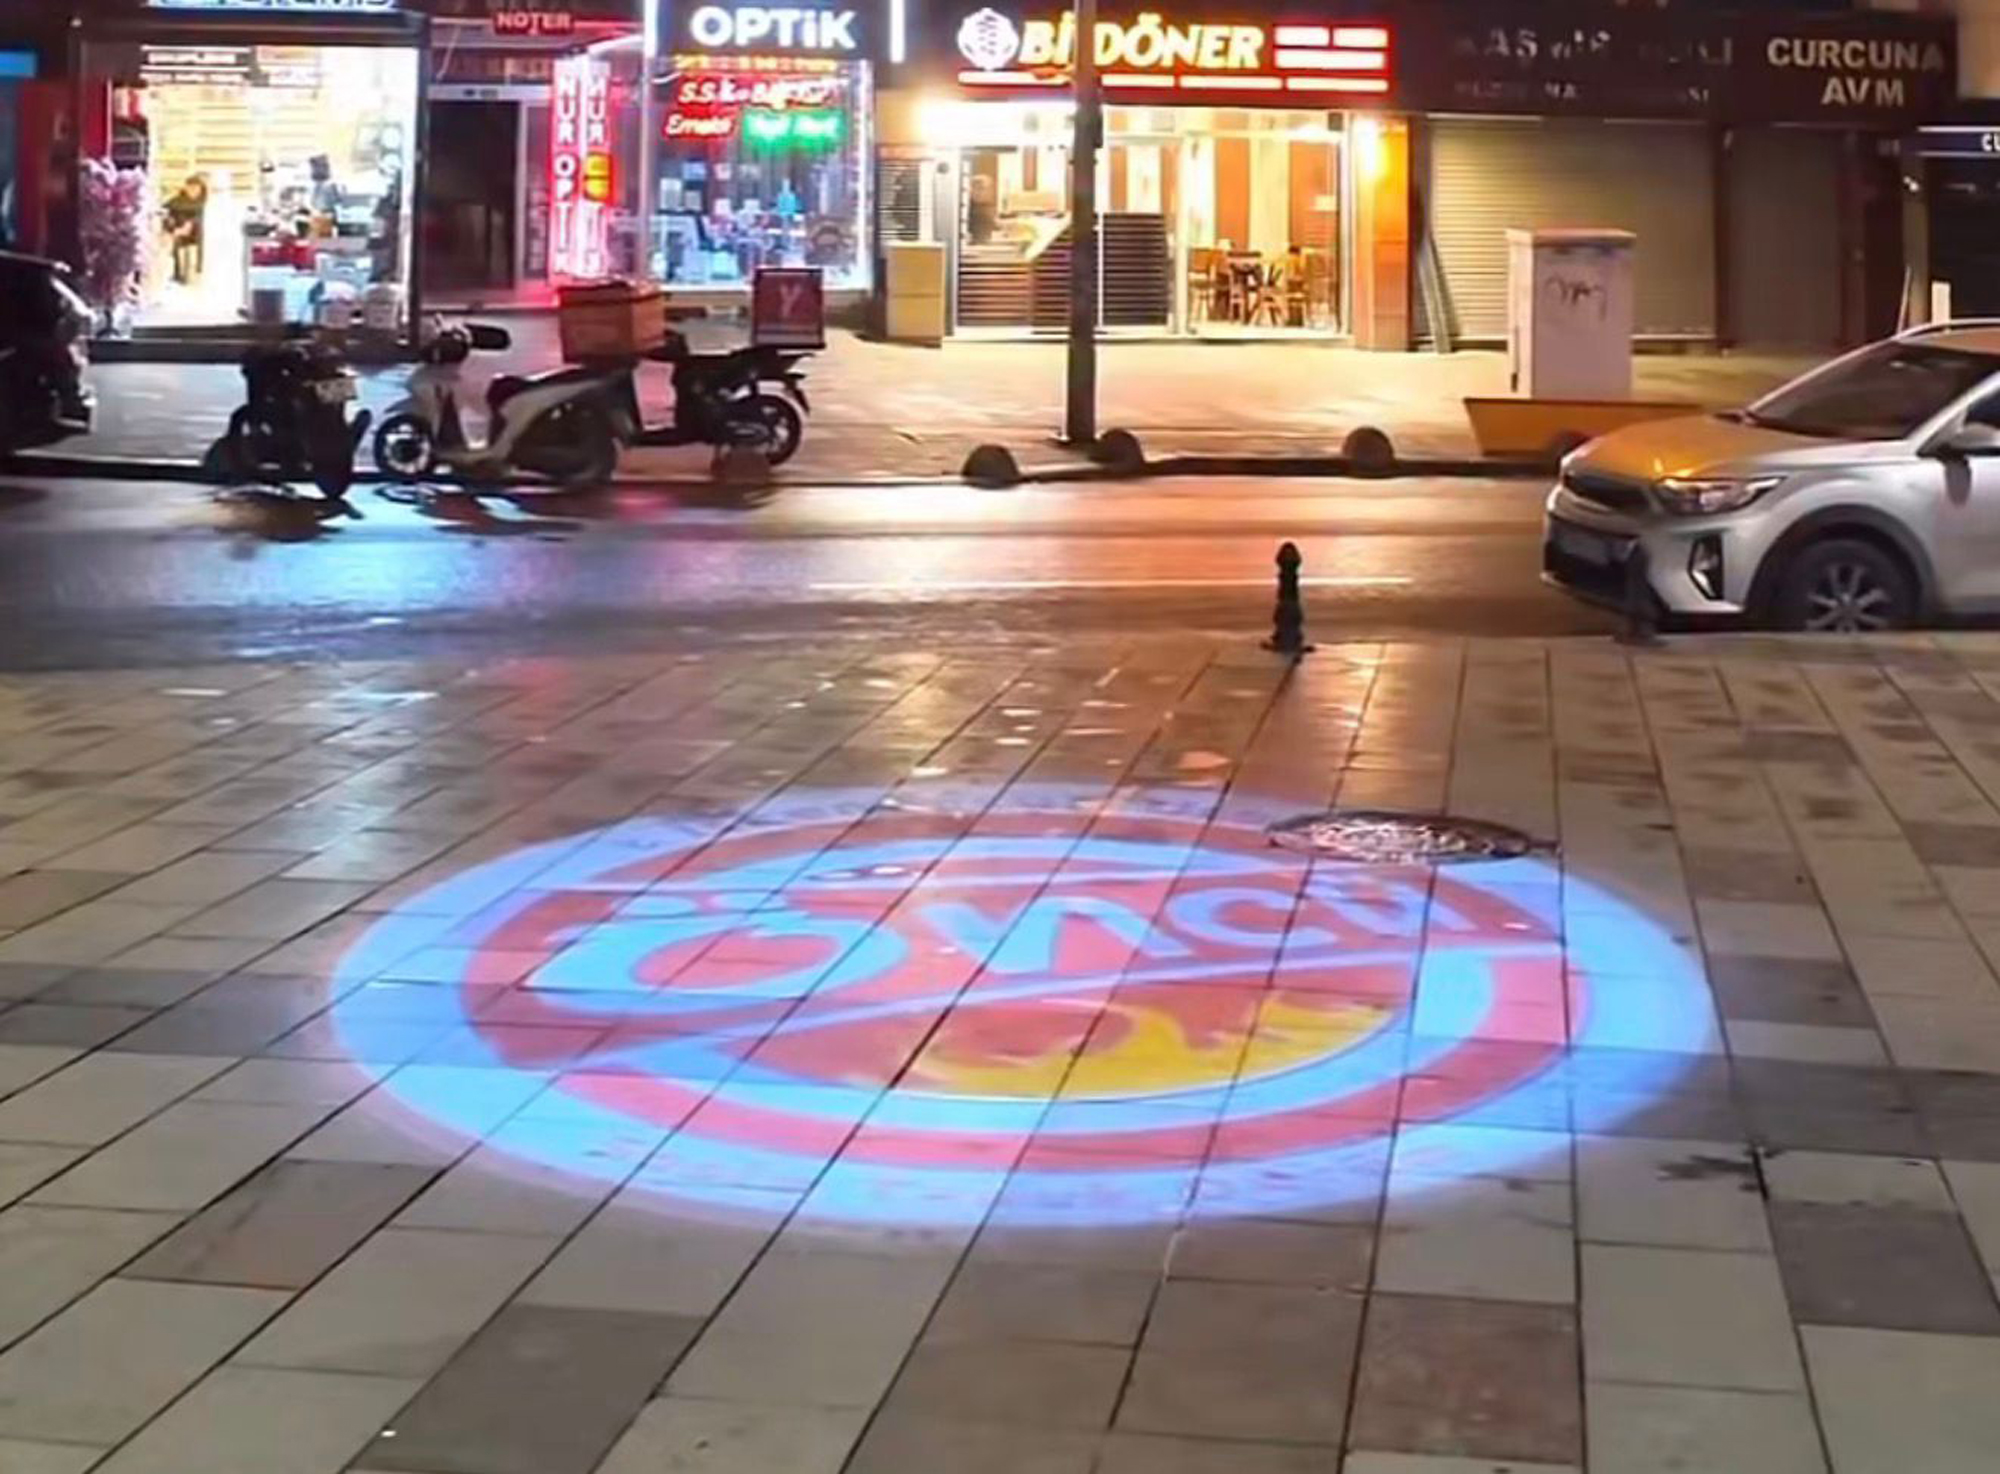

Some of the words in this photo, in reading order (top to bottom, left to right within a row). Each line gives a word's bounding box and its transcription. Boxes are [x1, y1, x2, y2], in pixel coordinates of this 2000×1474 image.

[1093, 12, 1265, 69] DÖNER
[1766, 37, 1943, 71] CURCUNA
[1821, 77, 1905, 107] AVM
